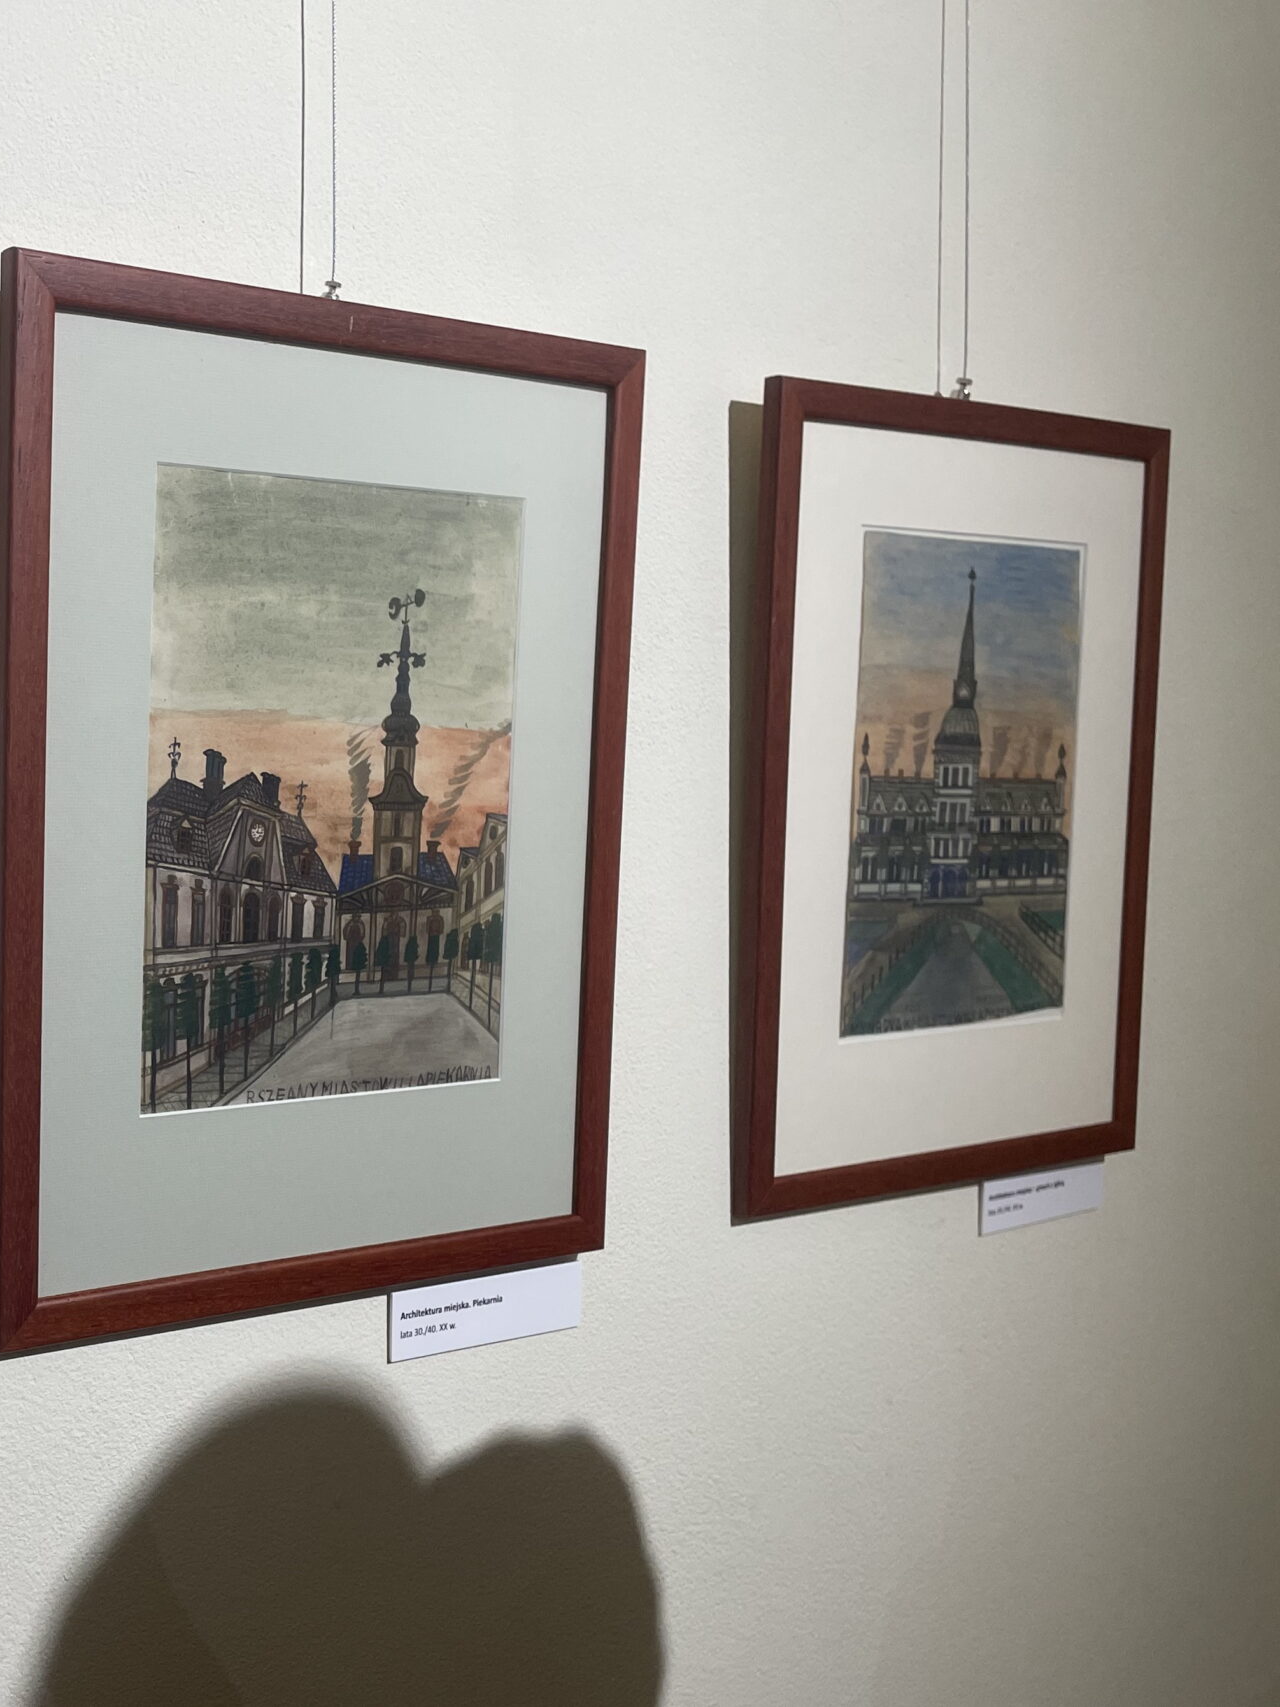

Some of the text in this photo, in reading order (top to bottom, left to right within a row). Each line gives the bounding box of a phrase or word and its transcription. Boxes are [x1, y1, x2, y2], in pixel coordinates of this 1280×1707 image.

[400, 1294, 503, 1321] Architektura miejska. Piekarnia
[400, 1322, 457, 1339] lata 30./40. XX w.
